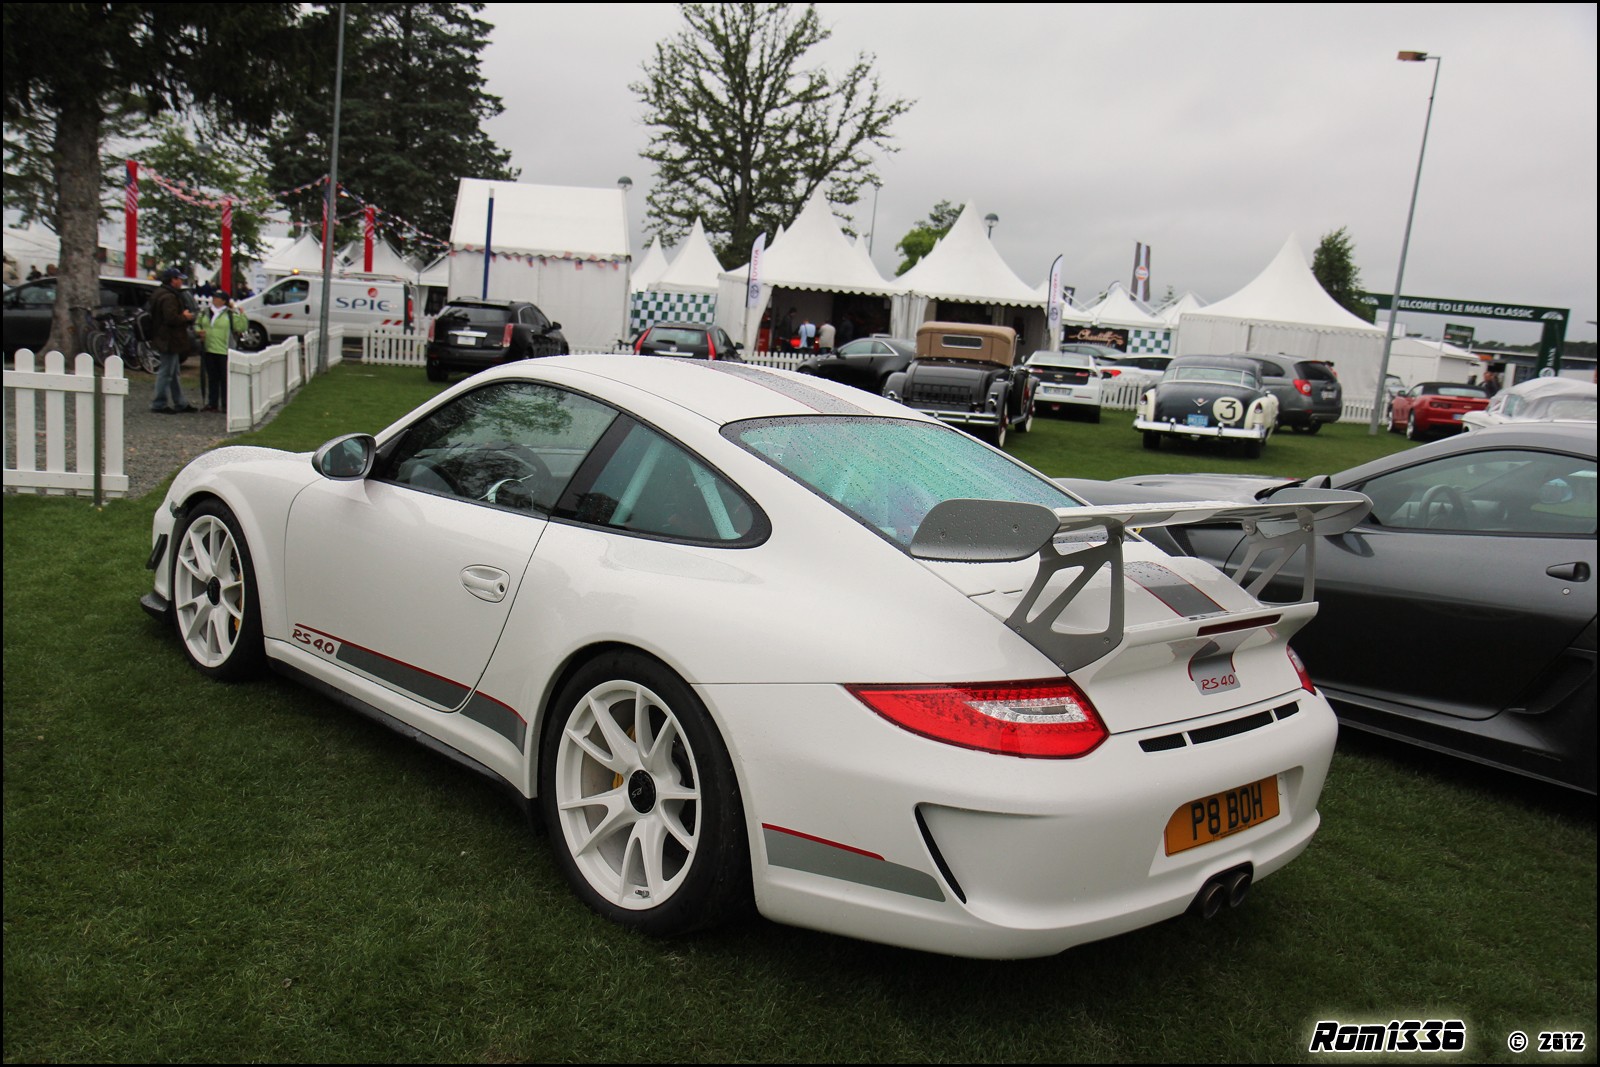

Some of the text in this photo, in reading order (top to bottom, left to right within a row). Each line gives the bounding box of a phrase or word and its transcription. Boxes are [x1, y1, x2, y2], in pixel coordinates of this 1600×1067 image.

[752, 249, 760, 283] TOYOTA
[335, 288, 391, 312] SPIE
[1438, 302, 1451, 312] TO
[1452, 303, 1463, 313] LE
[1464, 304, 1494, 315] MANS
[1494, 307, 1535, 318] CLASSIC
[1220, 400, 1236, 420] 3
[292, 628, 335, 655] RS 4.0
[1200, 677, 1220, 690] RS
[1190, 783, 1263, 841] P8 BOH
